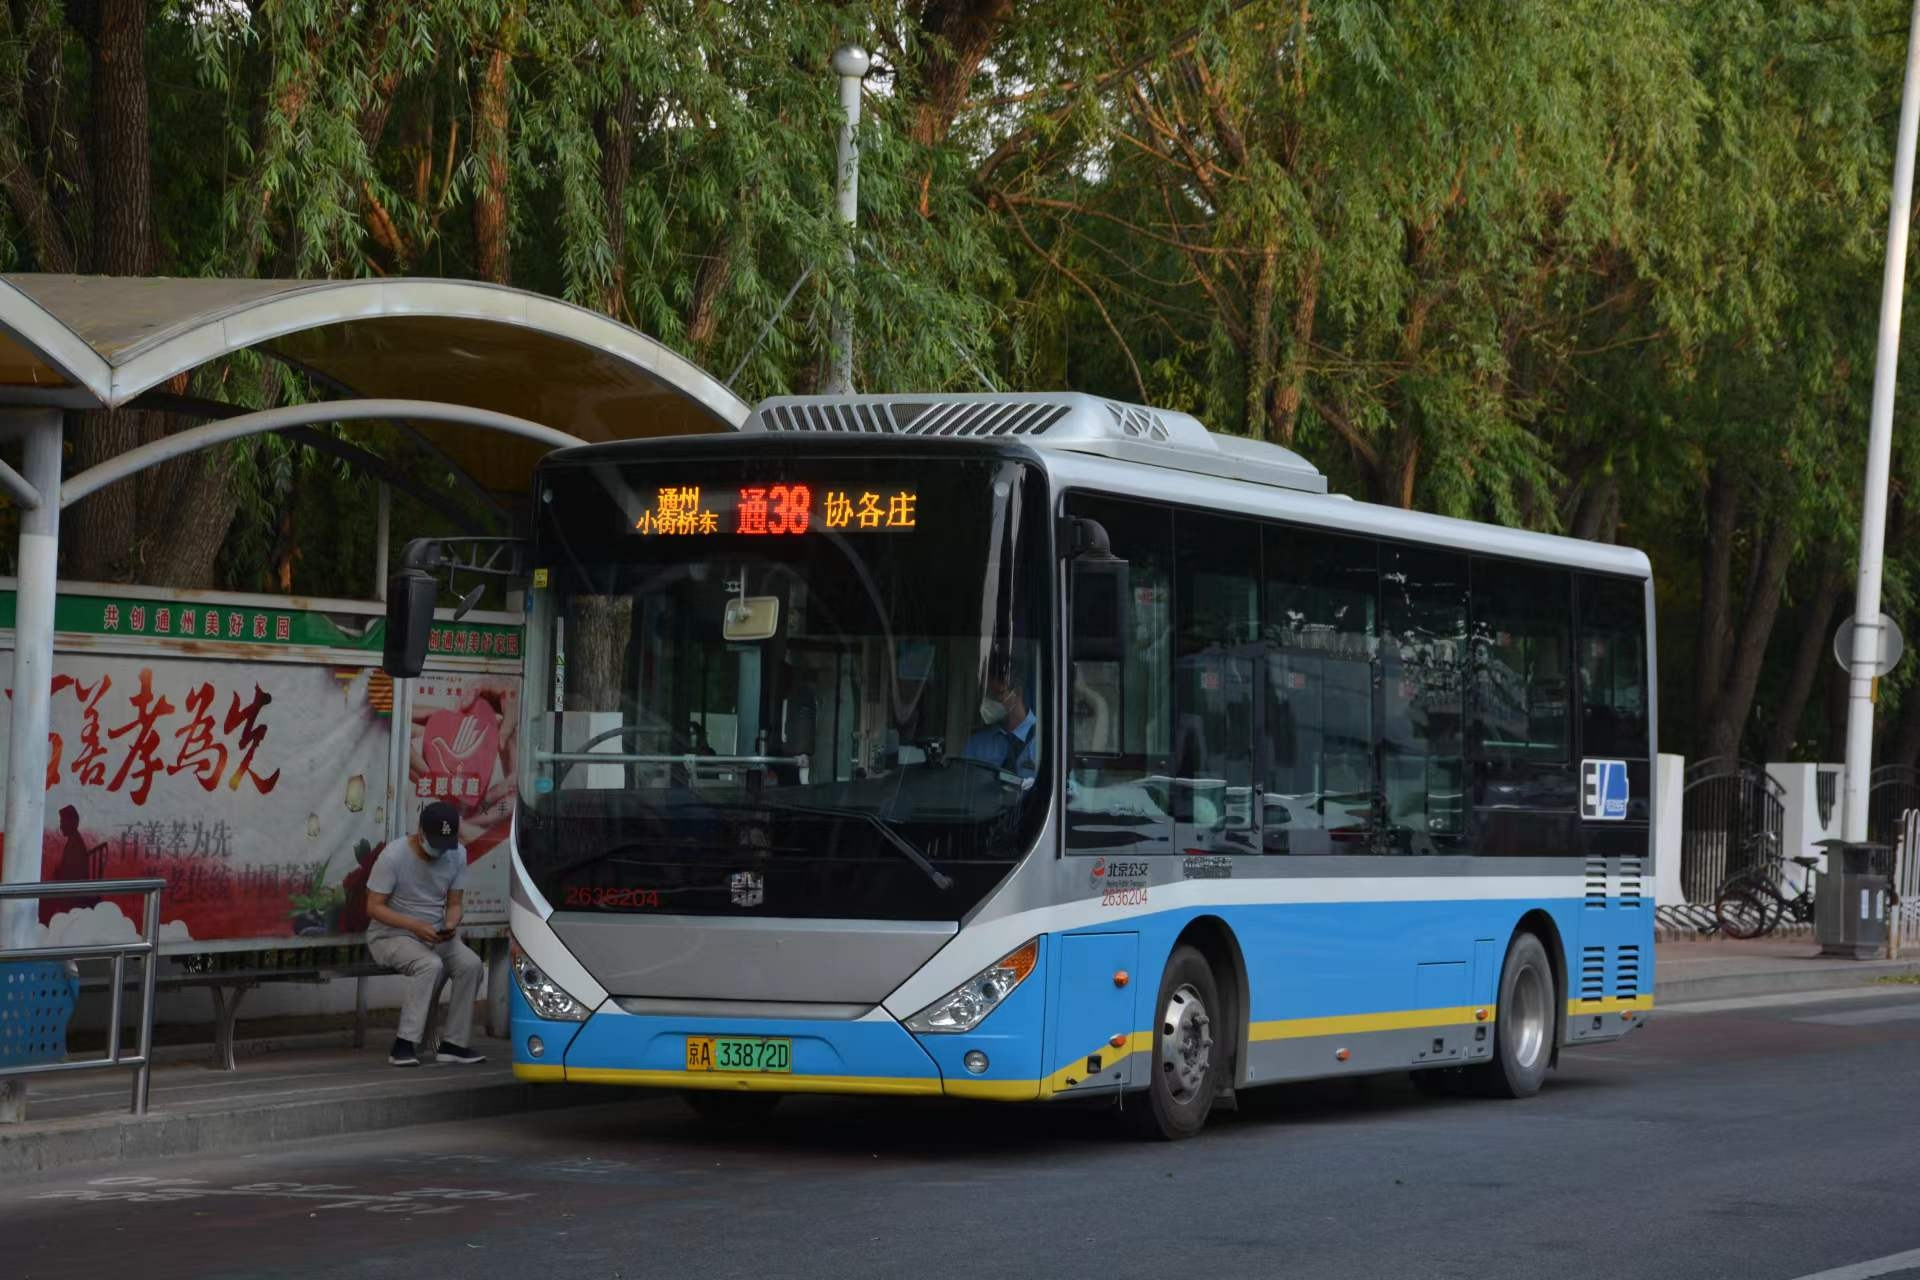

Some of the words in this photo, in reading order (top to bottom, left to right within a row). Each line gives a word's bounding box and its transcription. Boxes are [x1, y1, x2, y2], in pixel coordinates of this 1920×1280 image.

[658, 487, 700, 512] 通州
[737, 486, 810, 534] 通38
[824, 491, 917, 528] 协各庄
[636, 509, 719, 535] 小街桥东
[104, 604, 292, 641] 共创通州美好家园
[1107, 862, 1149, 877] 北京公交
[563, 886, 660, 907] 2636204
[1102, 887, 1148, 907] 2636204
